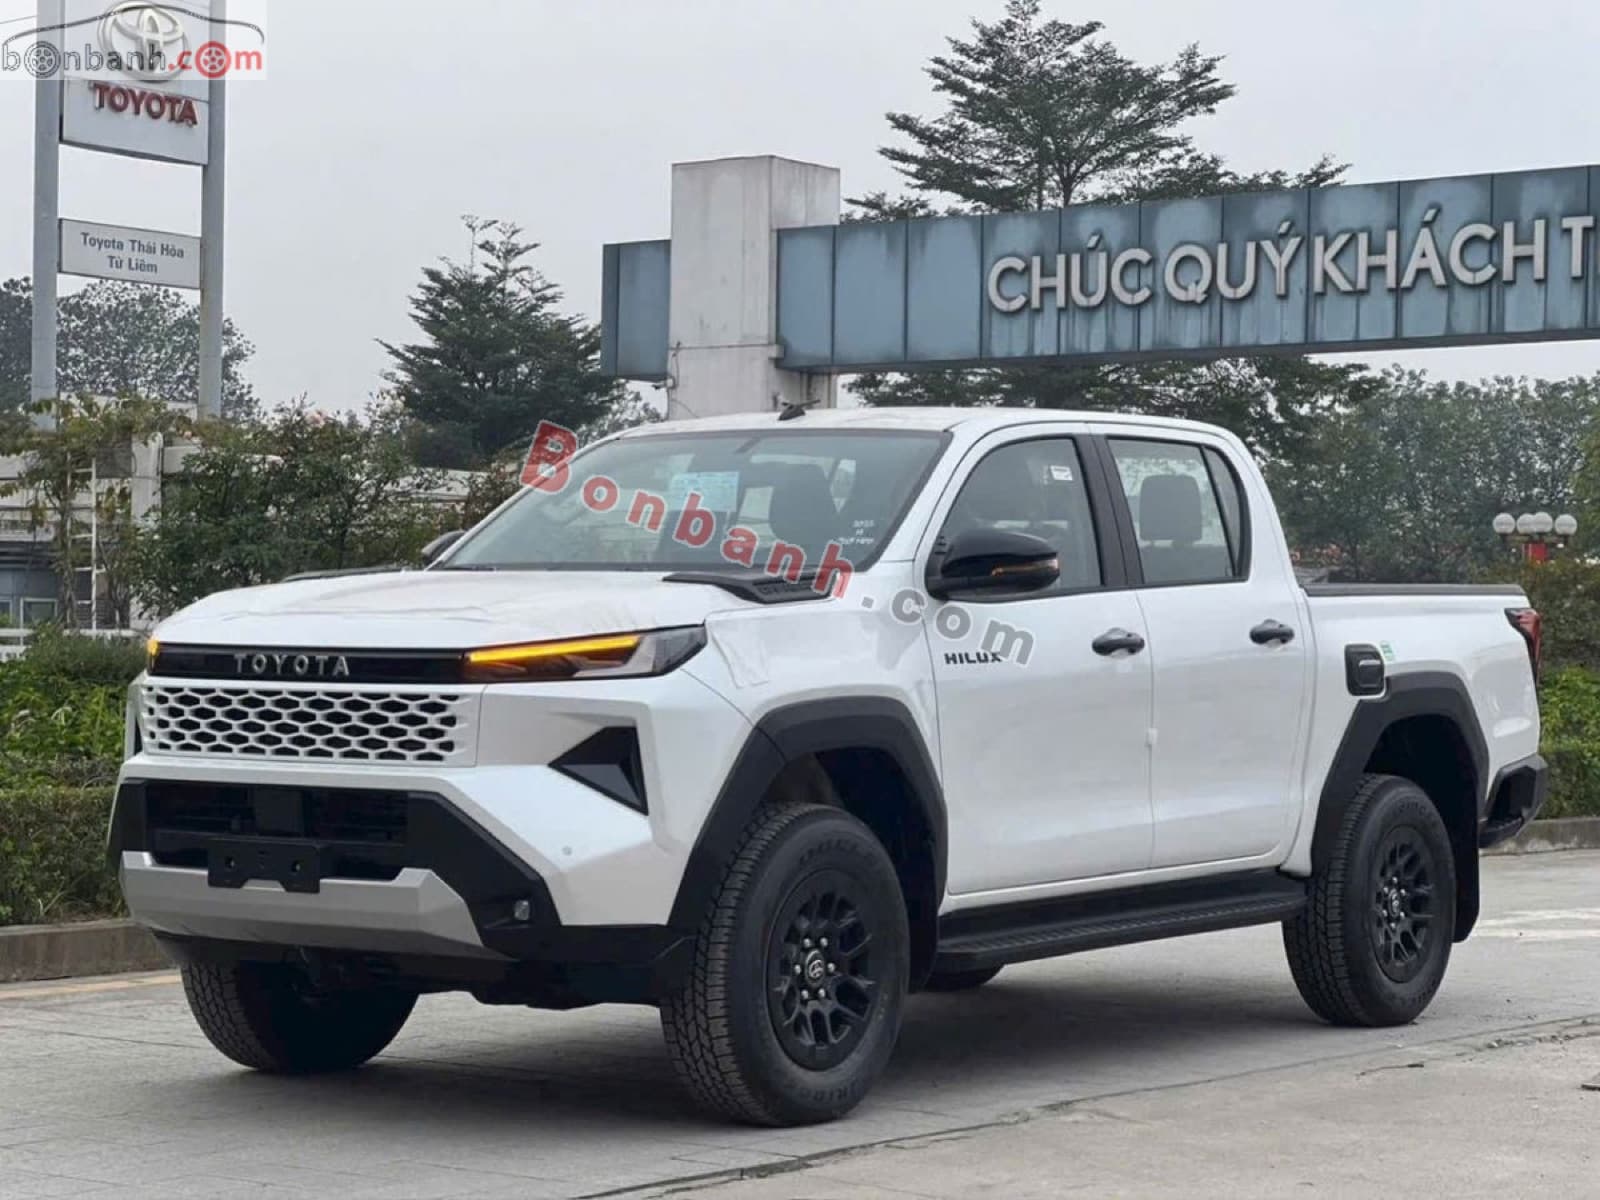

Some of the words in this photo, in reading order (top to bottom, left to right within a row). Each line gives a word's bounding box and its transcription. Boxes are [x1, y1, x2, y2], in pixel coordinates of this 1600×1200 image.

[92, 83, 198, 127] TOYOTA
[81, 232, 124, 251] Toyota
[129, 239, 156, 255] Thái
[987, 235, 1152, 313] CHÚC
[1163, 221, 1302, 303] QUÝ
[1313, 208, 1546, 294] KHÁCH
[233, 652, 350, 676] TOYOTA
[944, 652, 1002, 665] HILUX
